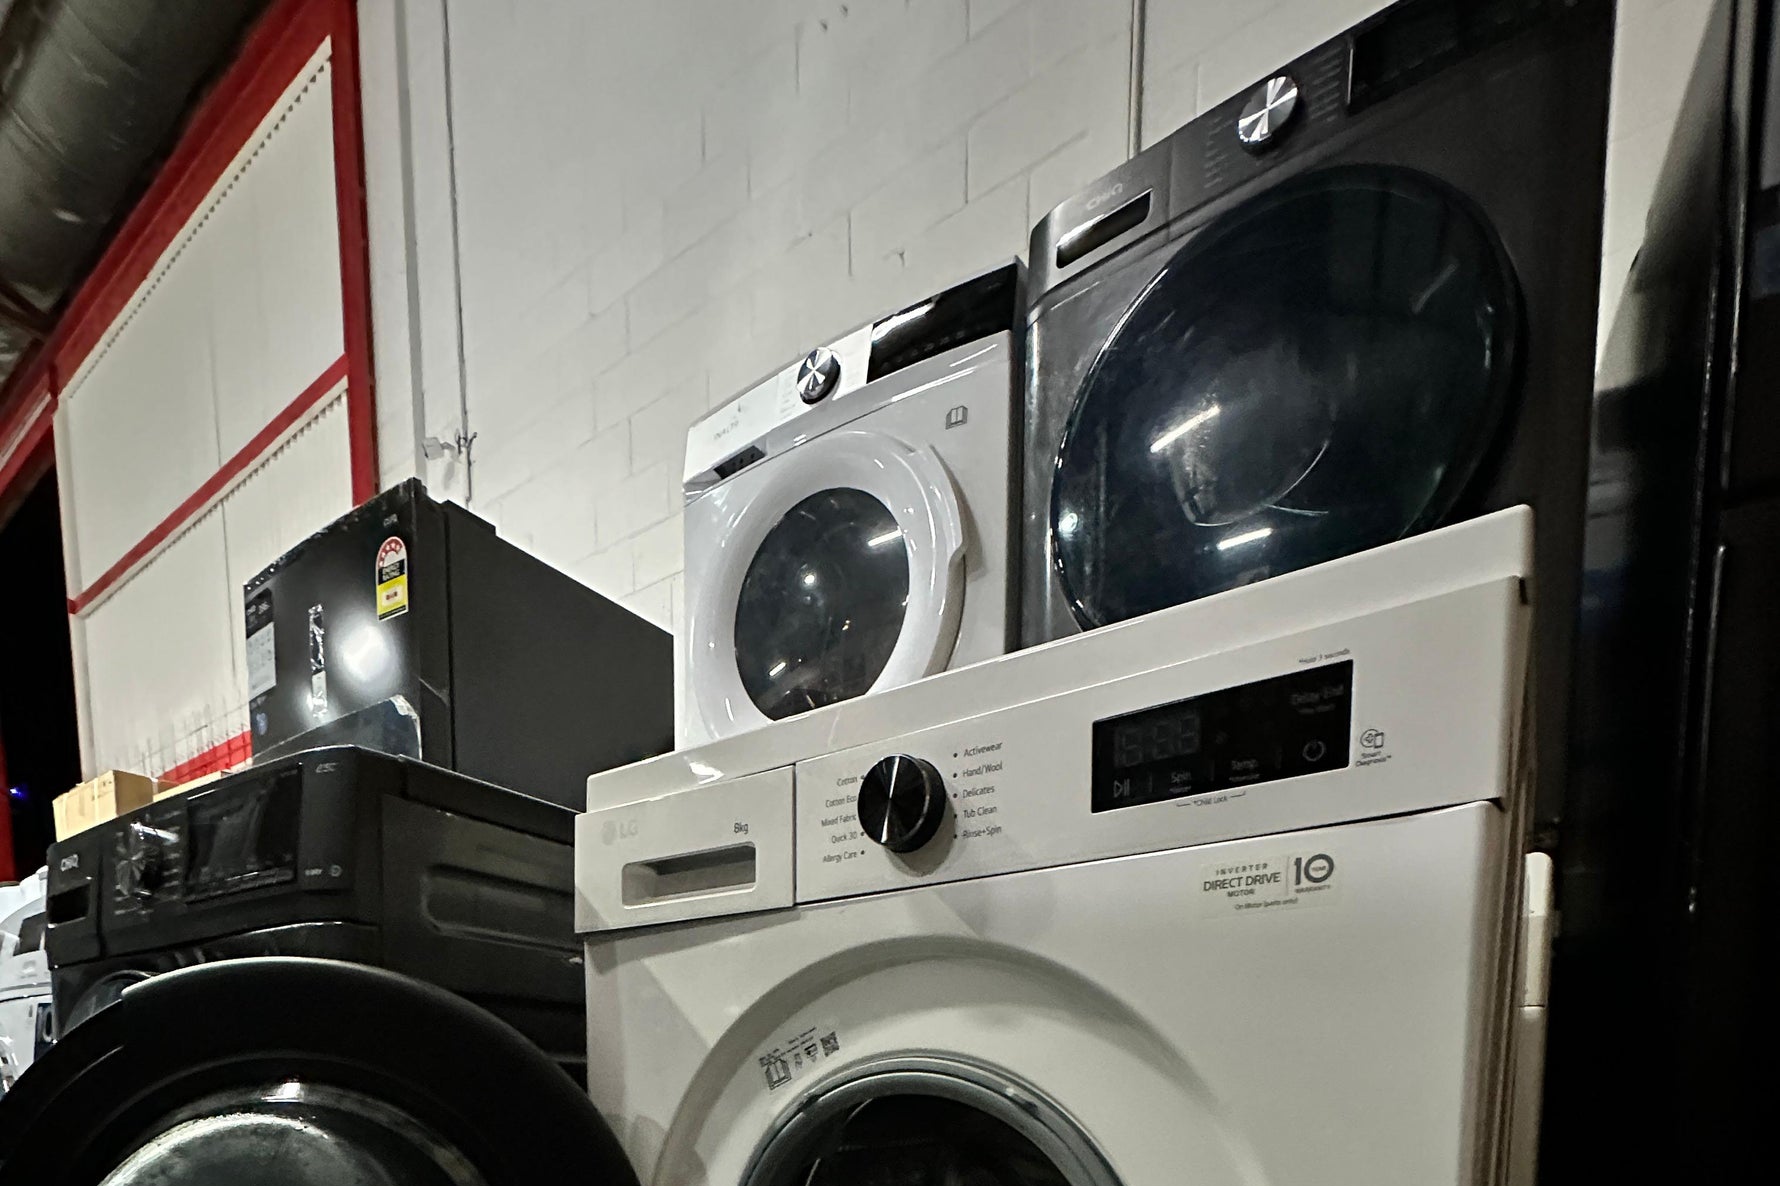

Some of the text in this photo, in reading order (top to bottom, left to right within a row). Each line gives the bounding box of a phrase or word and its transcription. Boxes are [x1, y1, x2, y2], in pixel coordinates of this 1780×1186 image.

[963, 742, 1003, 758] Activewear
[962, 761, 1003, 779] Hand/Wool
[1171, 771, 1192, 784] Spin
[837, 775, 858, 788] Cotton
[962, 784, 995, 799] Delicates
[825, 797, 846, 809] Cotton
[963, 805, 997, 819] Tub Clean
[821, 814, 857, 828] Mixed Fabric
[619, 819, 639, 840] LG
[962, 825, 1002, 841] Rinse+Spin
[831, 833, 848, 845] Quick
[823, 850, 858, 865] Allergy Care
[1216, 862, 1268, 877] INVERTER
[1294, 853, 1335, 886] 10
[1203, 871, 1282, 892] DIRECT DRIVE
[1227, 888, 1256, 898] MOTOR
